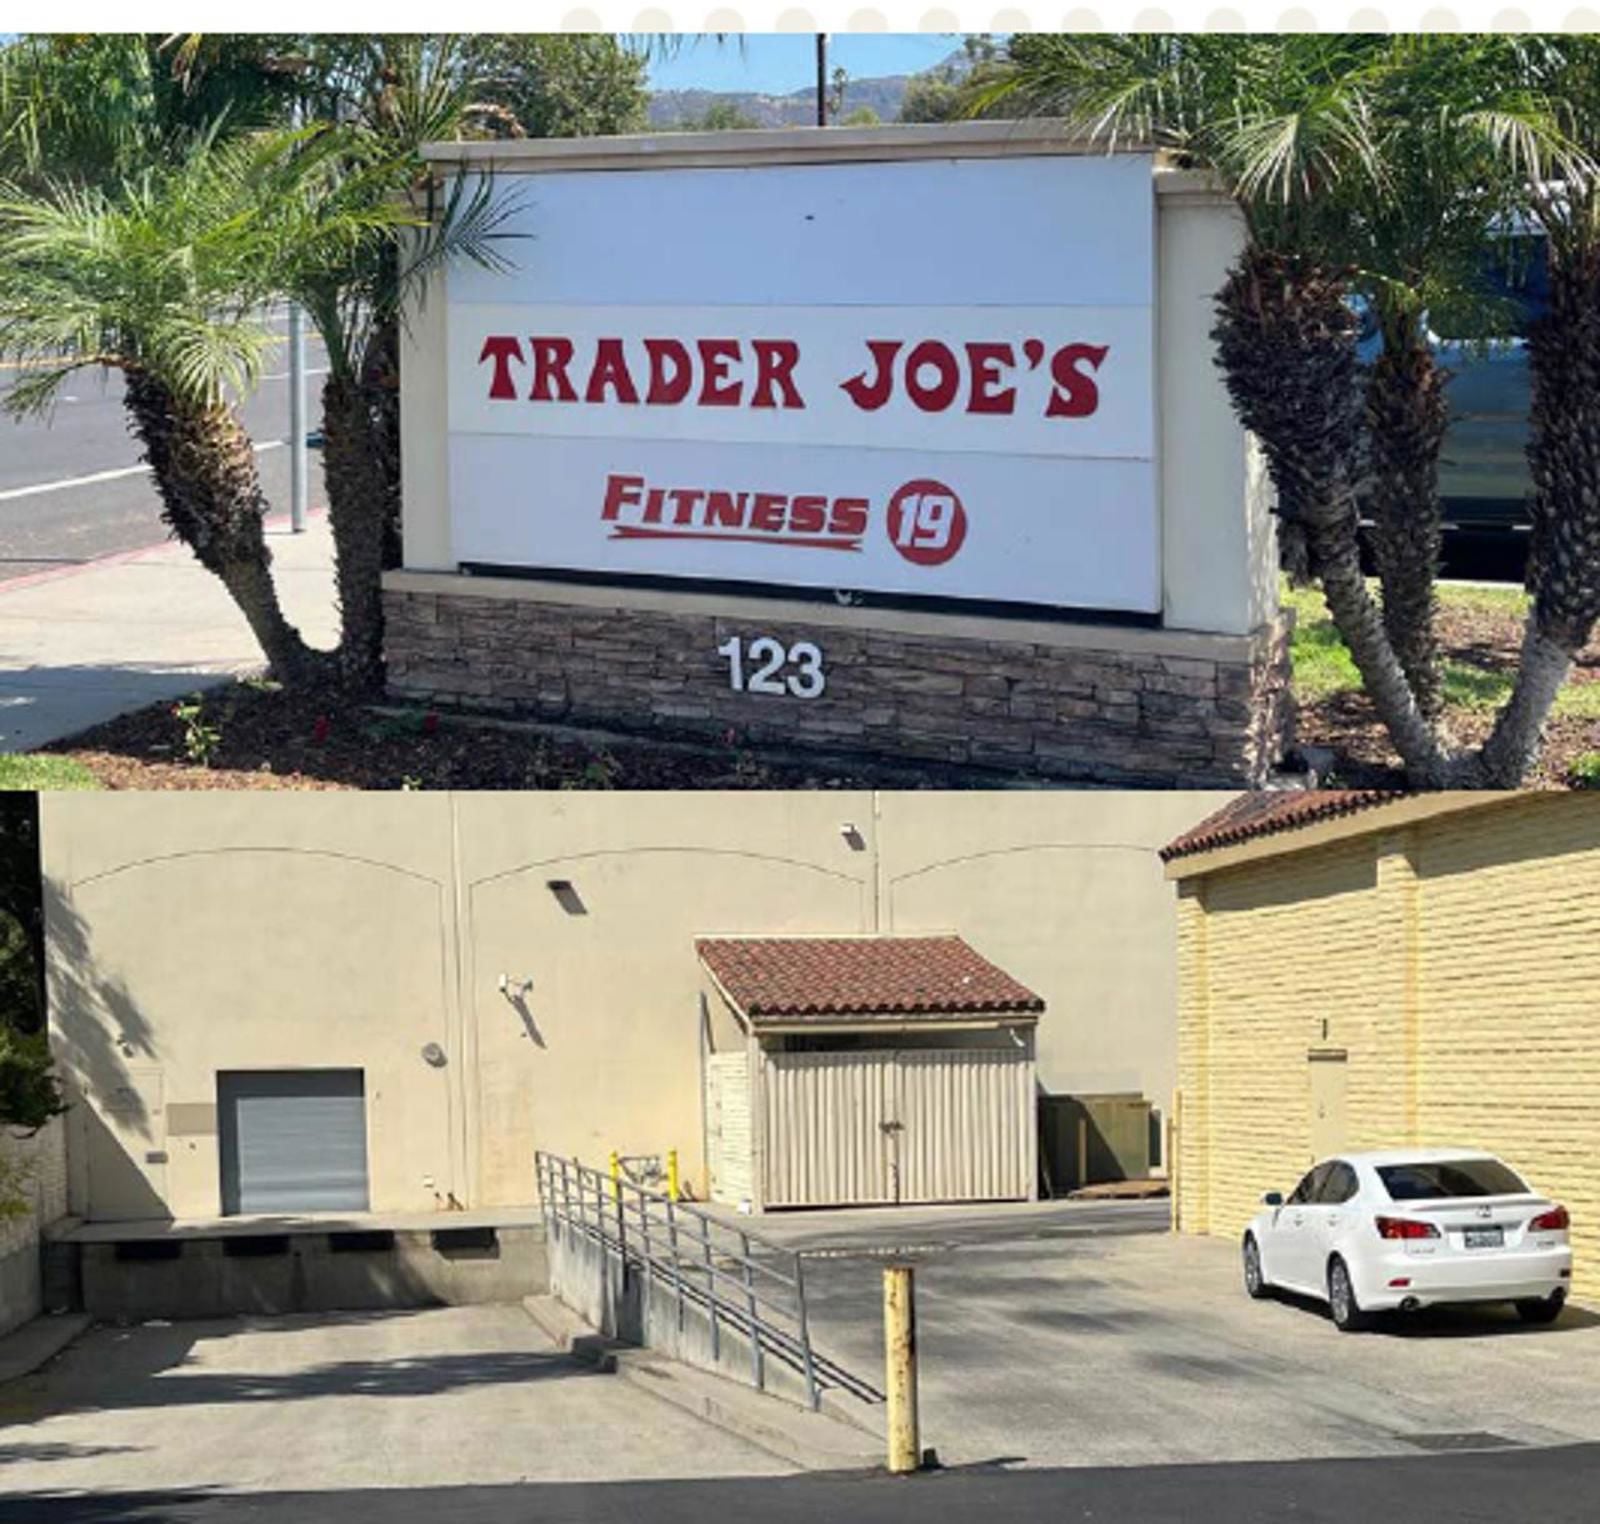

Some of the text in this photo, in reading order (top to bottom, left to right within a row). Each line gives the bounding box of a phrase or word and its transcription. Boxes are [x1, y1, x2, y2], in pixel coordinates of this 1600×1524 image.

[479, 335, 1110, 419] TRADER JOE'S
[601, 474, 955, 550] FITNESS 19
[717, 636, 826, 699] 123
